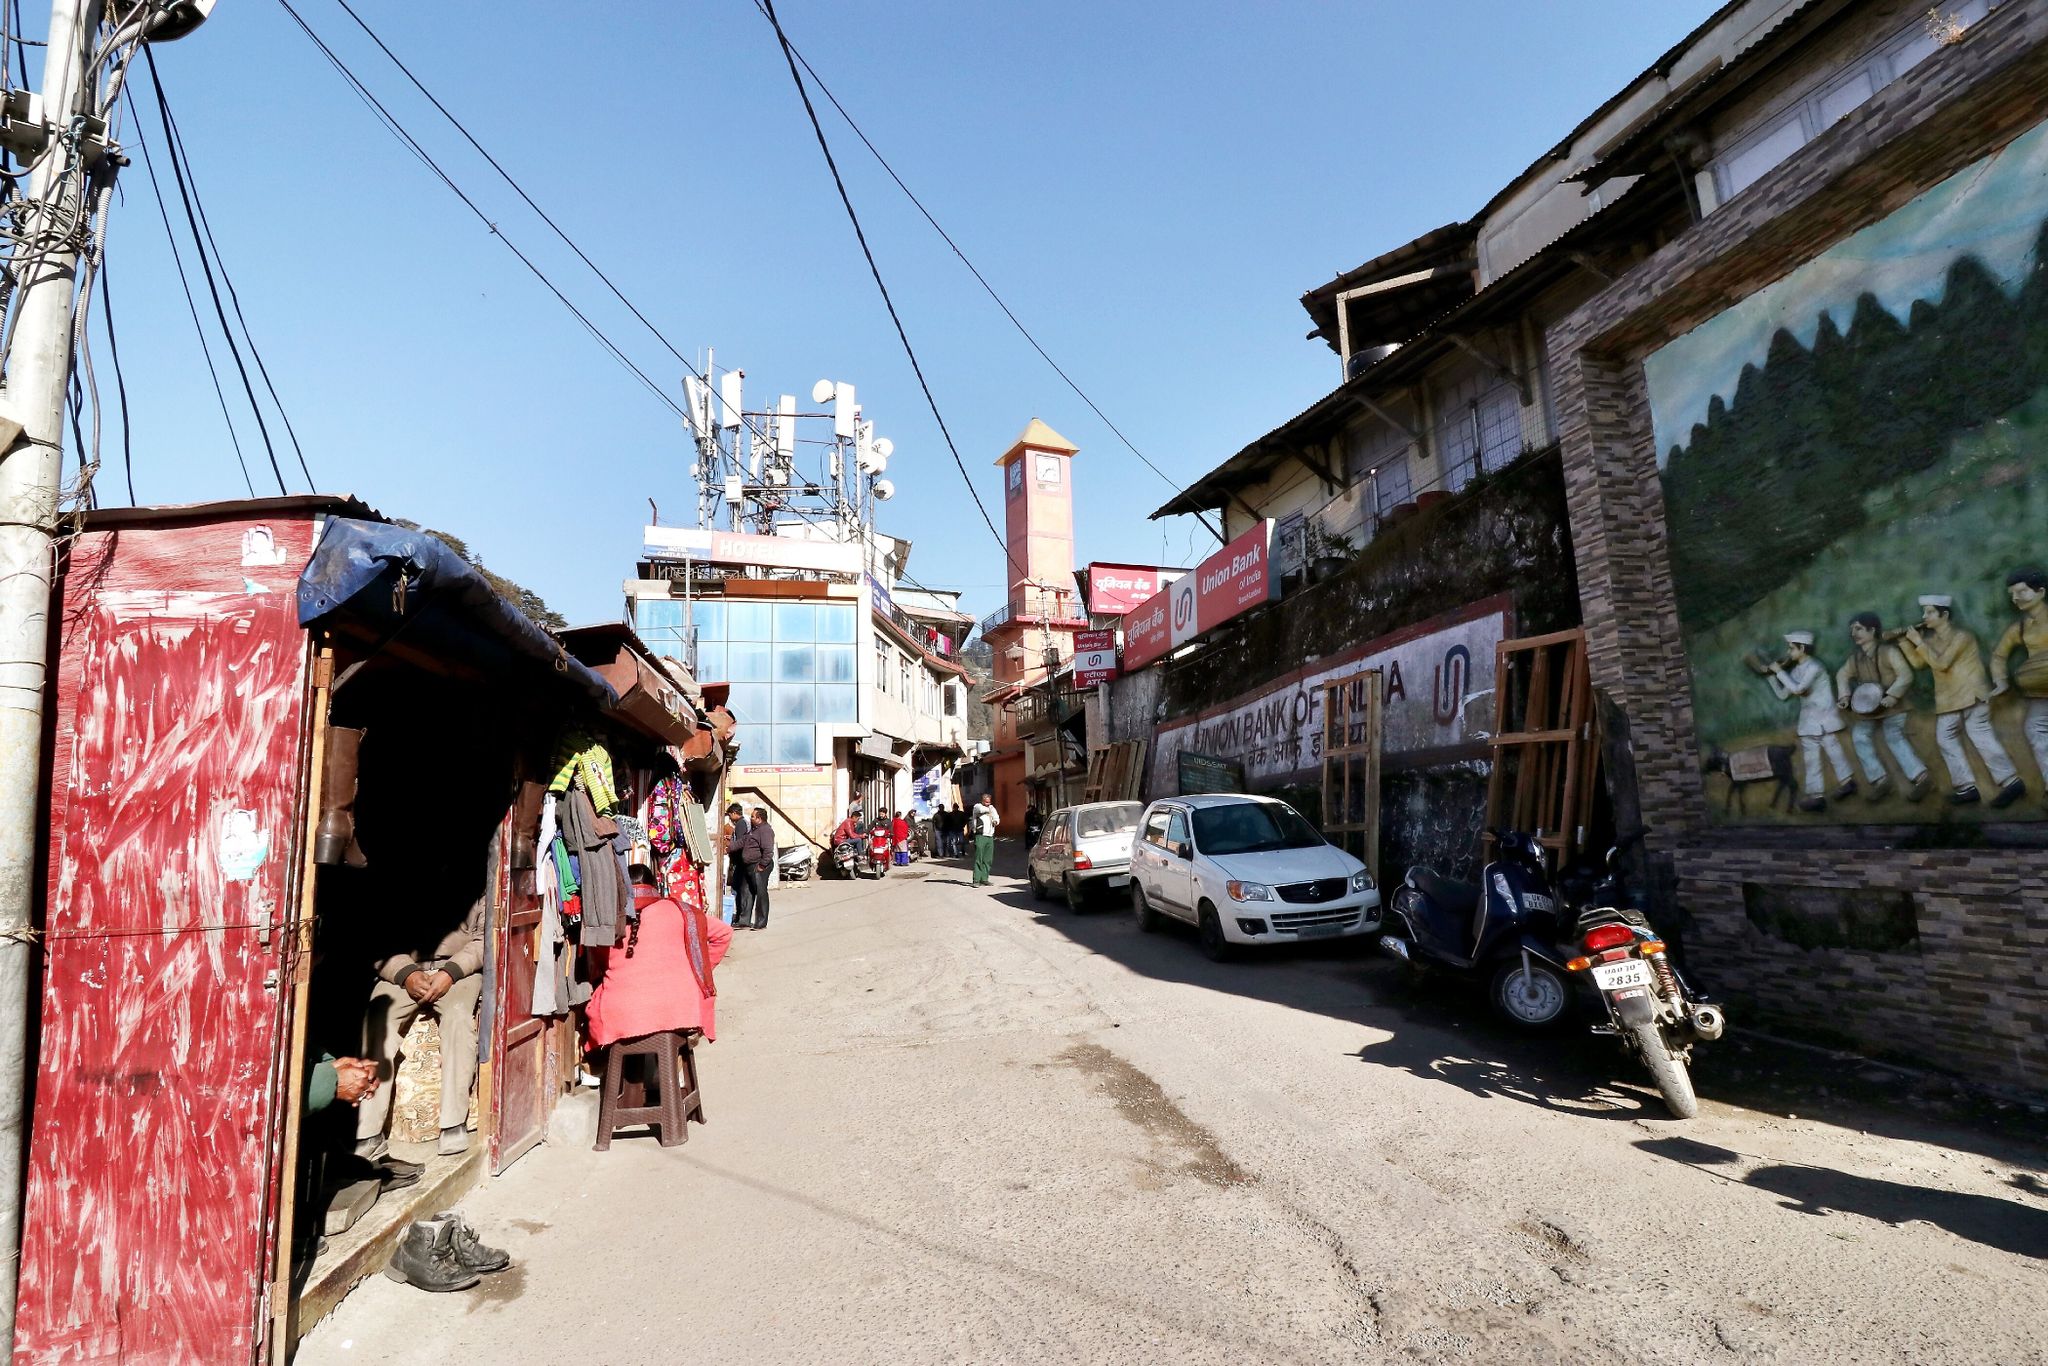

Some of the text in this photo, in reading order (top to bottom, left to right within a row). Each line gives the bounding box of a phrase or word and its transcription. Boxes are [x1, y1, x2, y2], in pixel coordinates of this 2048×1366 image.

[719, 539, 780, 561] HOTEL
[1095, 576, 1132, 592] यूनियन
[1202, 544, 1261, 595] Union Bank
[1127, 606, 1165, 648] यूनियन बैंक
[1193, 716, 1240, 754] UNION
[1243, 696, 1288, 745] BANK
[1294, 684, 1325, 728] OF
[1608, 972, 1641, 986] 2835
